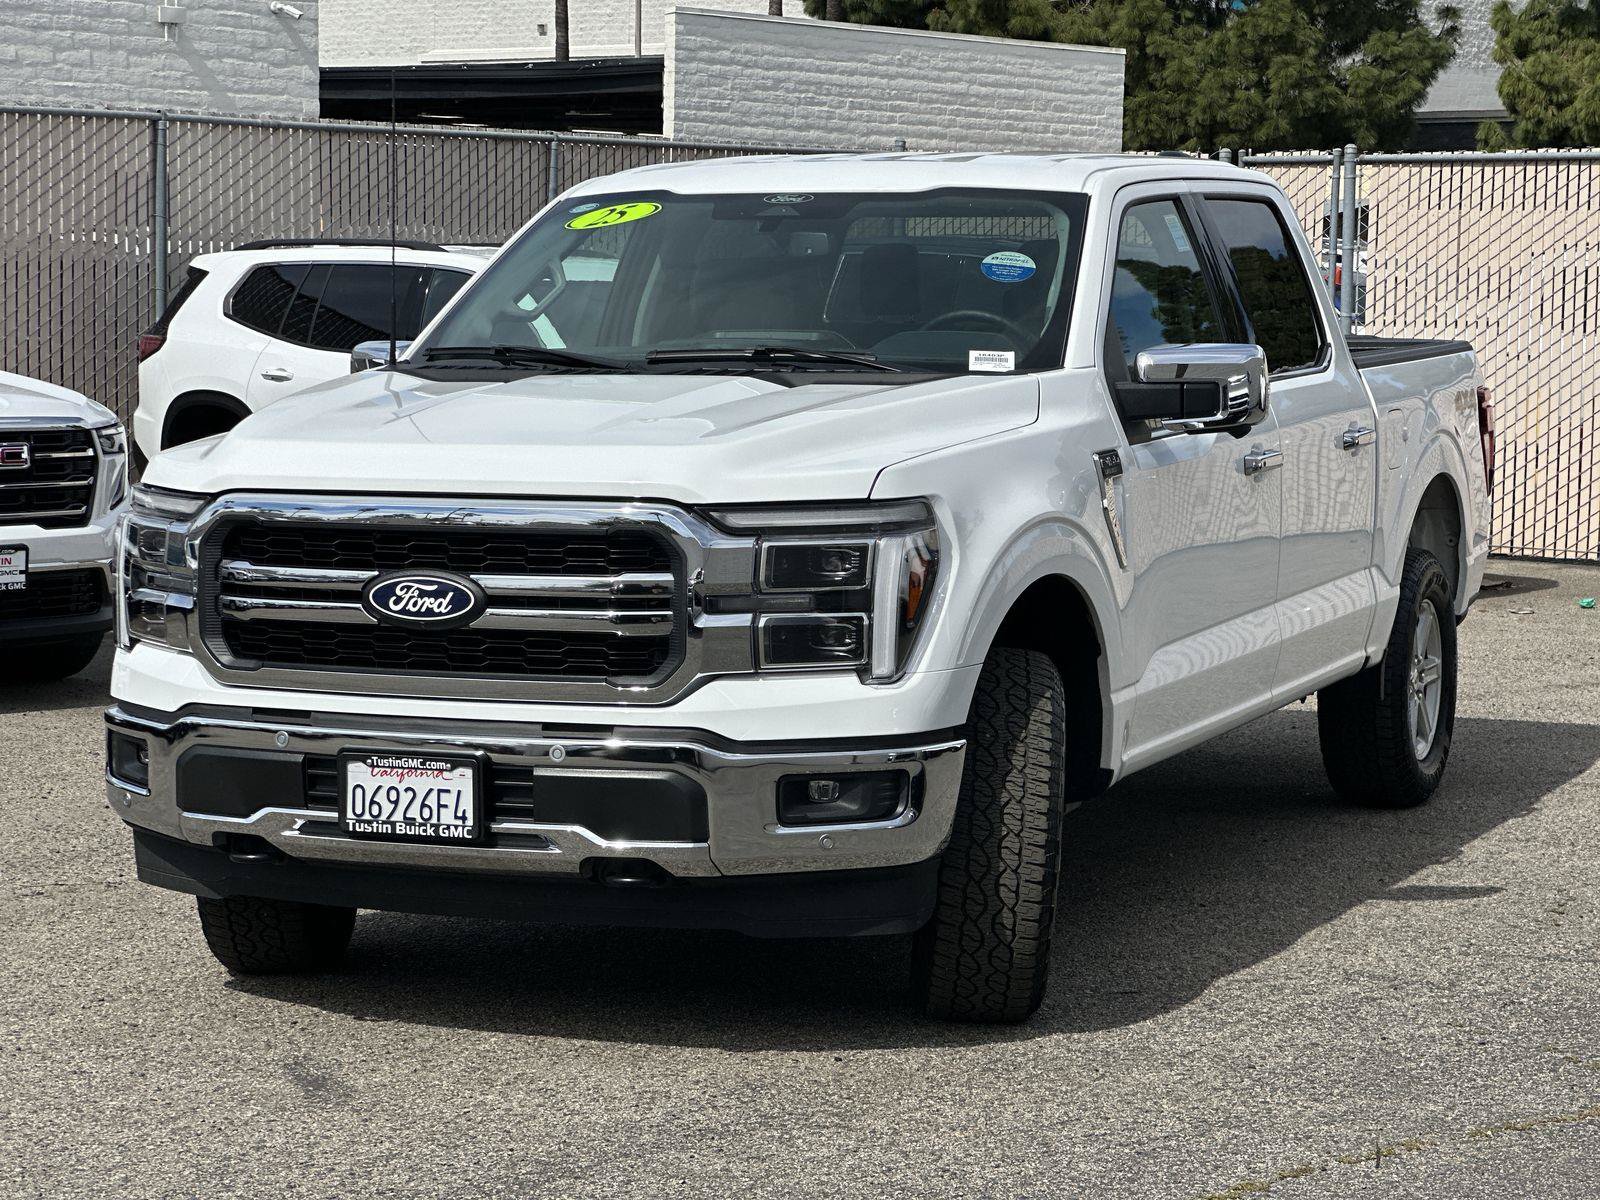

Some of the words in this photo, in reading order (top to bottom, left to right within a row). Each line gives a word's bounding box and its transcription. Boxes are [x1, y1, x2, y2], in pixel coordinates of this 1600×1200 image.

[583, 204, 639, 227] 25
[8, 582, 26, 590] GMC
[388, 582, 454, 613] Ford
[371, 756, 446, 770] TustinGMC.com
[370, 766, 453, 783] California
[352, 783, 468, 825] 06926F4
[346, 819, 392, 834] Tustin
[395, 822, 436, 837] Buick
[439, 825, 473, 839] GMC
